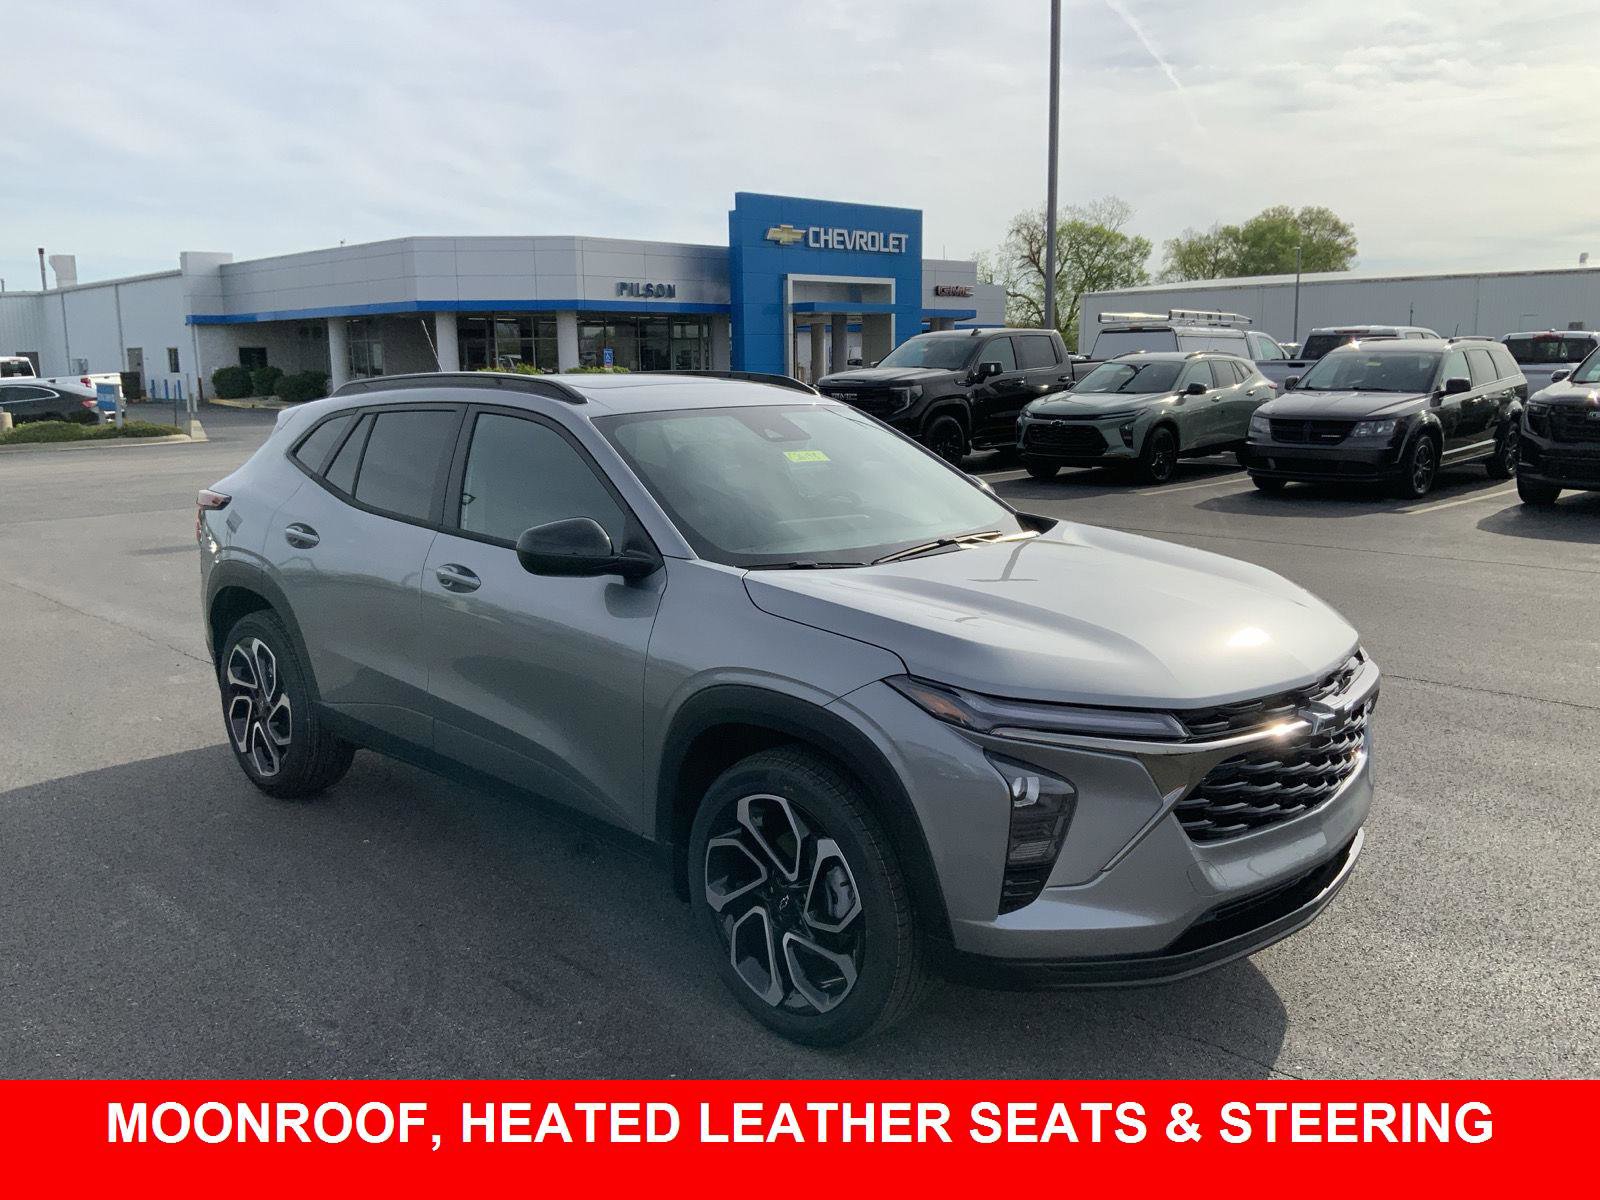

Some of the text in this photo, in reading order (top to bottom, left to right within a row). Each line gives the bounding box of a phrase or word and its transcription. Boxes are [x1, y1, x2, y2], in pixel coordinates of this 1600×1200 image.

[808, 226, 909, 253] CHEVROLET
[616, 282, 676, 298] PILSON
[936, 285, 976, 297] GMC
